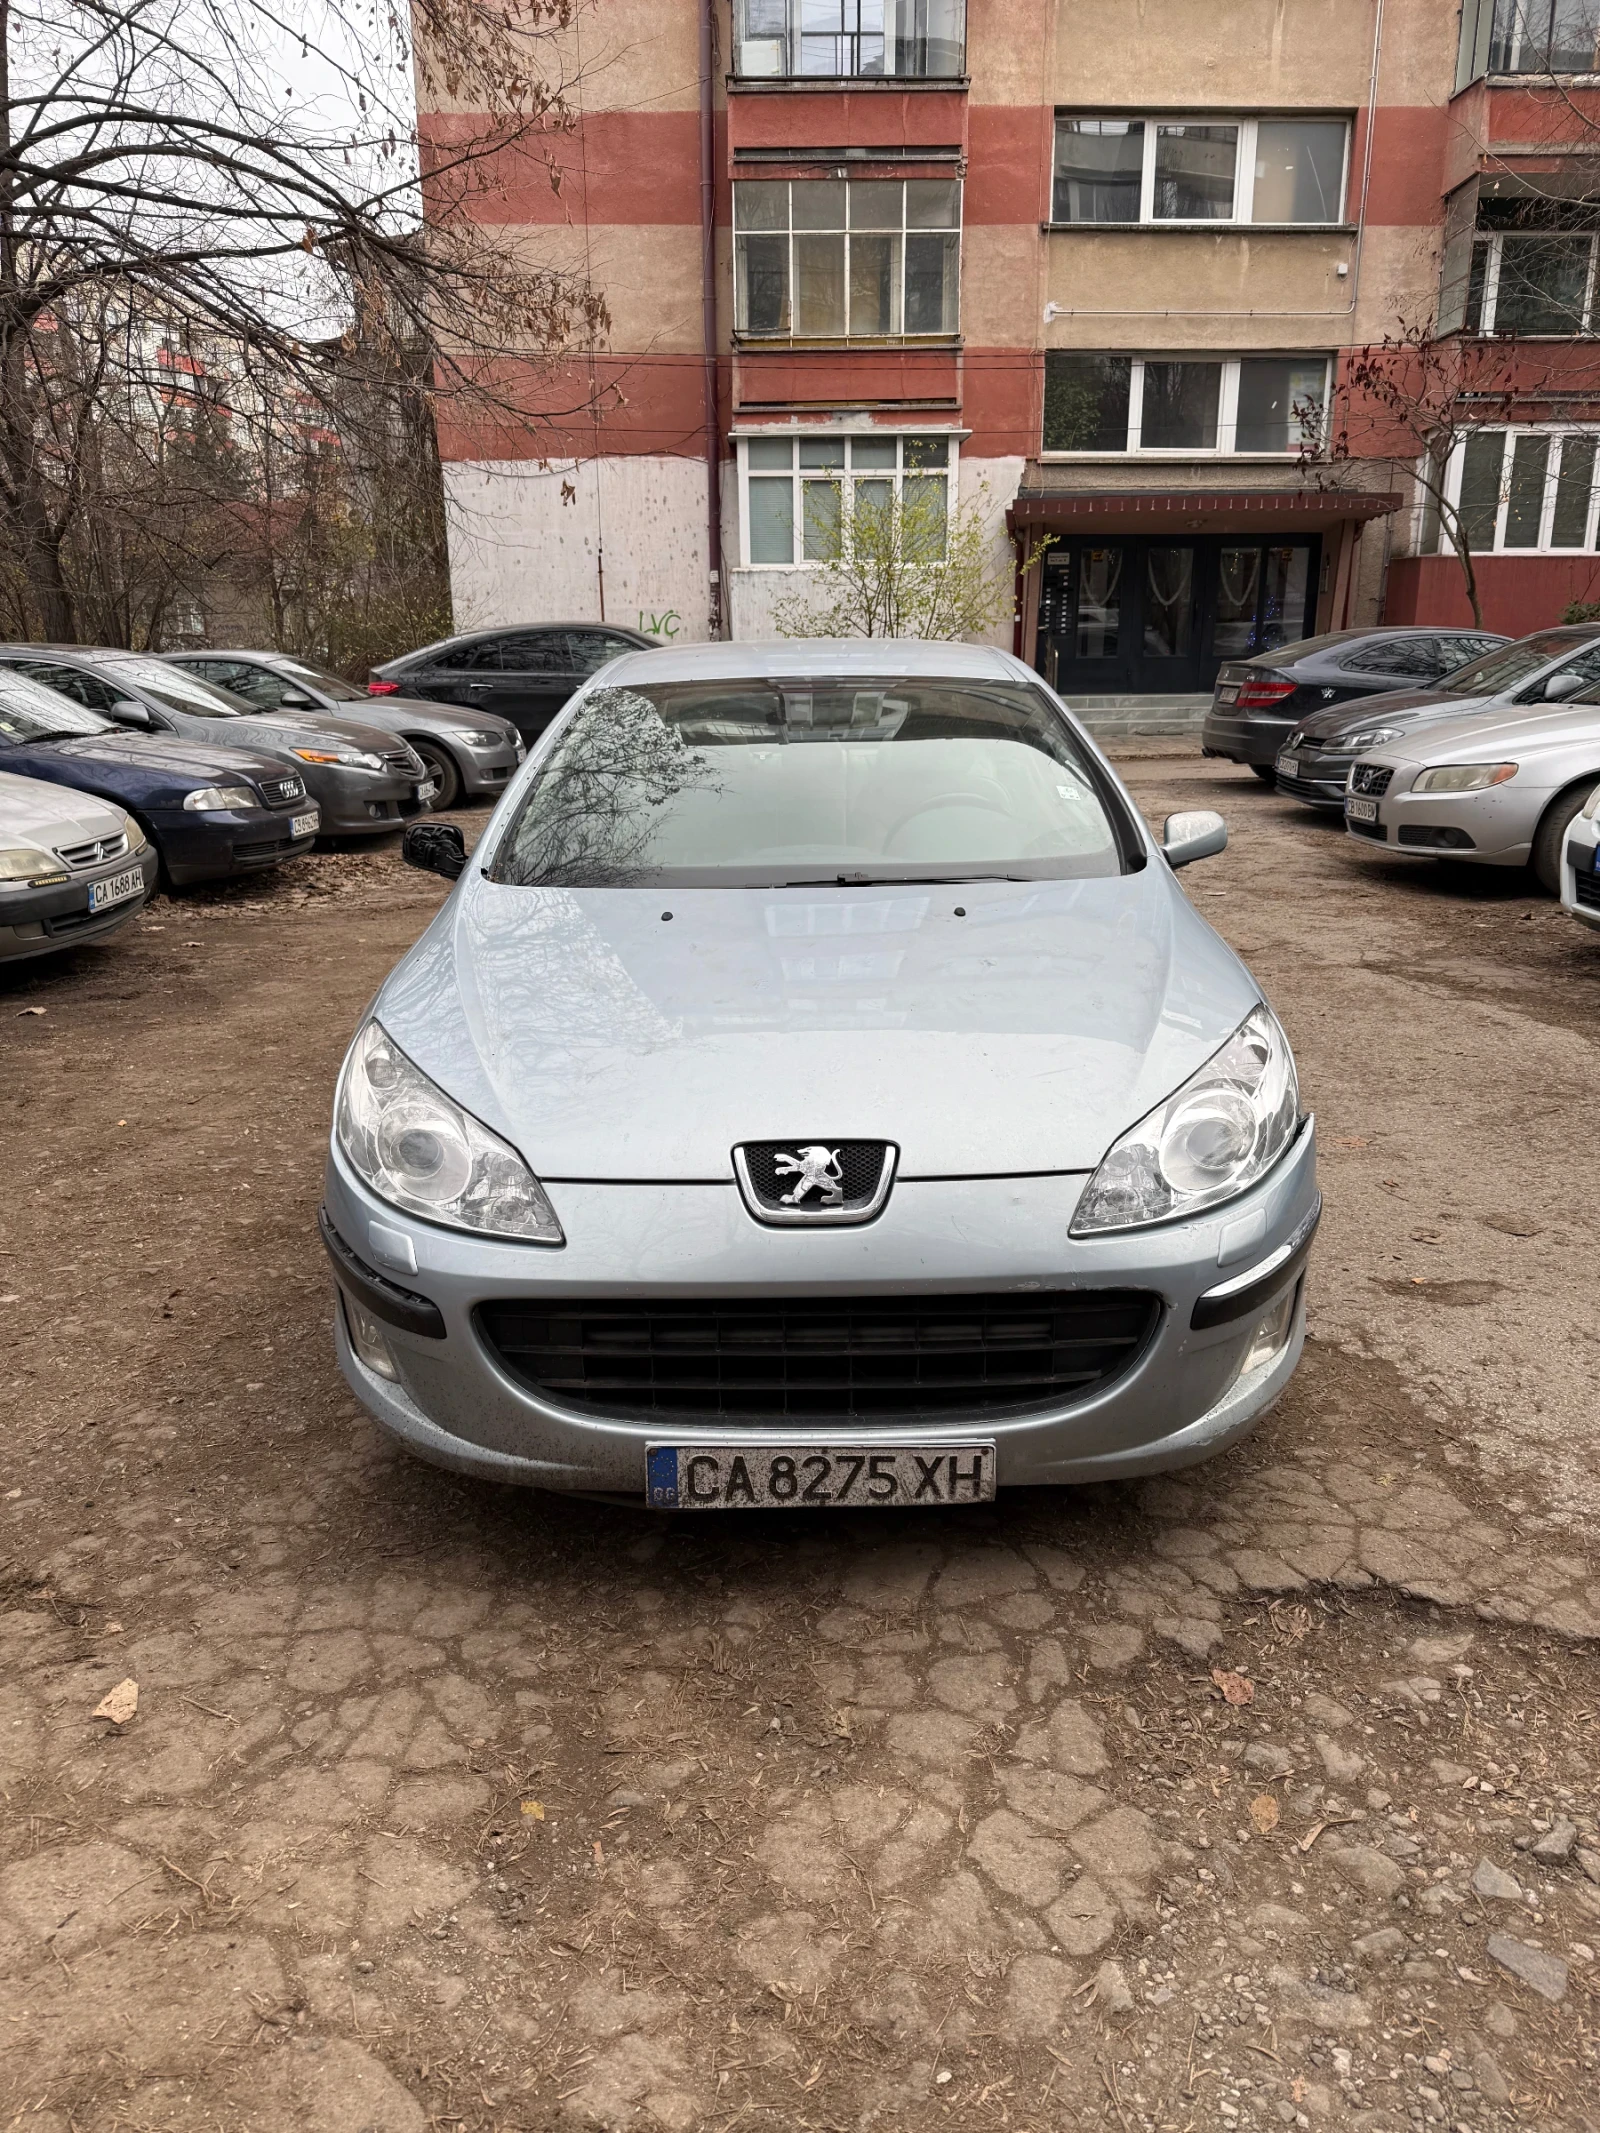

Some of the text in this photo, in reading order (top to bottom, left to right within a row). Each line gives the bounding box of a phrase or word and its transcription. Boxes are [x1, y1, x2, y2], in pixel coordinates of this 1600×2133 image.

[1348, 799, 1355, 814] CB
[95, 868, 142, 903] CA 1688 AH
[687, 1455, 757, 1502] CA
[769, 1455, 898, 1500] 8275
[913, 1455, 982, 1499] XH
